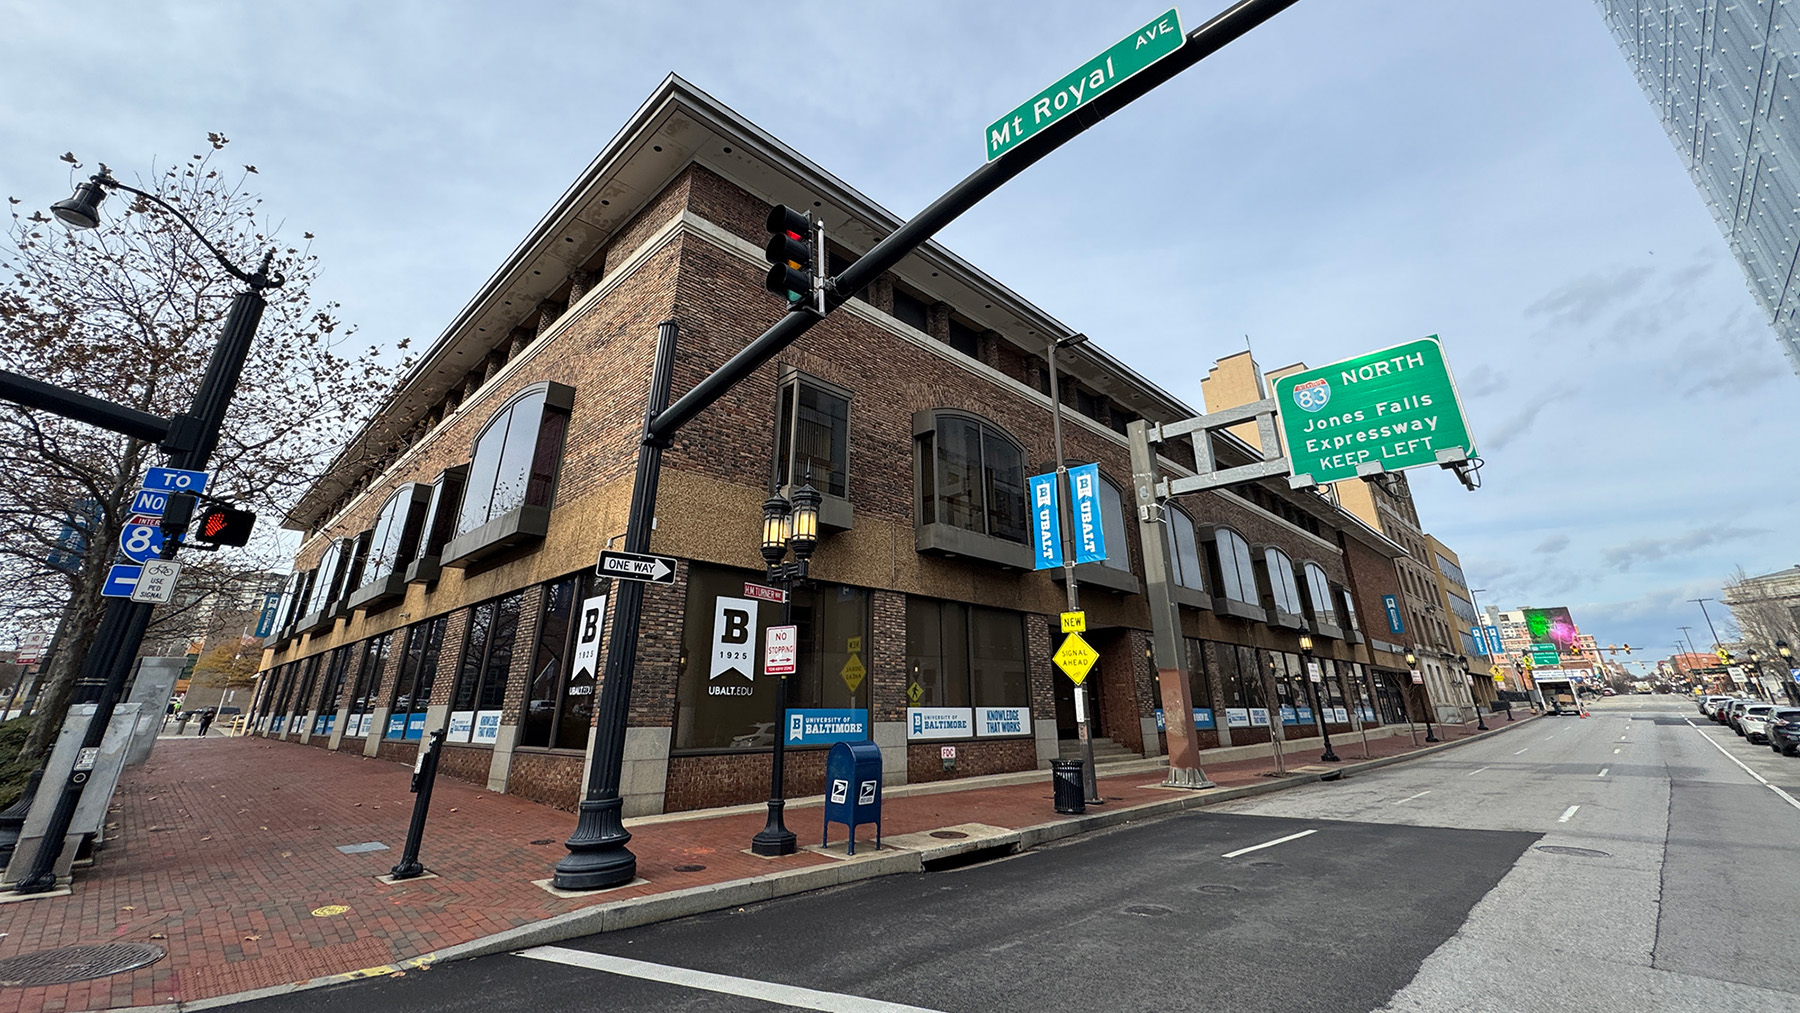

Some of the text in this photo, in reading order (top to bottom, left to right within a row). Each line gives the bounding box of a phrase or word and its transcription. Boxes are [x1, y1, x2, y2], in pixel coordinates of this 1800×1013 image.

[990, 19, 1172, 151] Mt Royal AVE
[1341, 352, 1424, 386] NORTH
[1299, 387, 1327, 408] 83
[1303, 394, 1433, 432] Jones Falls
[1306, 416, 1438, 453] Expressway
[1319, 436, 1433, 470] KEEP LEFT
[163, 472, 191, 488] TO
[1080, 478, 1089, 489] B
[1039, 487, 1048, 497] B
[1080, 500, 1096, 552] UBALT
[1039, 509, 1054, 559] UBALT
[608, 558, 656, 574] ONE WAY
[150, 577, 163, 585] USE
[147, 584, 161, 592] PED
[755, 587, 774, 599] TURNER
[140, 591, 162, 599] SIGNAL
[581, 607, 599, 644] B
[721, 608, 749, 644] B
[1063, 617, 1081, 627] NEW
[775, 632, 787, 640] NO
[578, 650, 594, 659] 1925
[720, 651, 747, 660] 1925
[768, 646, 793, 654] STOPPING
[1061, 649, 1088, 657] SIGNAL
[708, 686, 753, 696] UBALT.EDU
[914, 715, 921, 725] B
[986, 710, 1019, 720] KNOWLEDGE
[793, 718, 801, 730] B
[805, 723, 862, 734] BALTIMORE
[924, 720, 967, 729] BALTIMORE
[986, 721, 1021, 733] THAT WORKS
